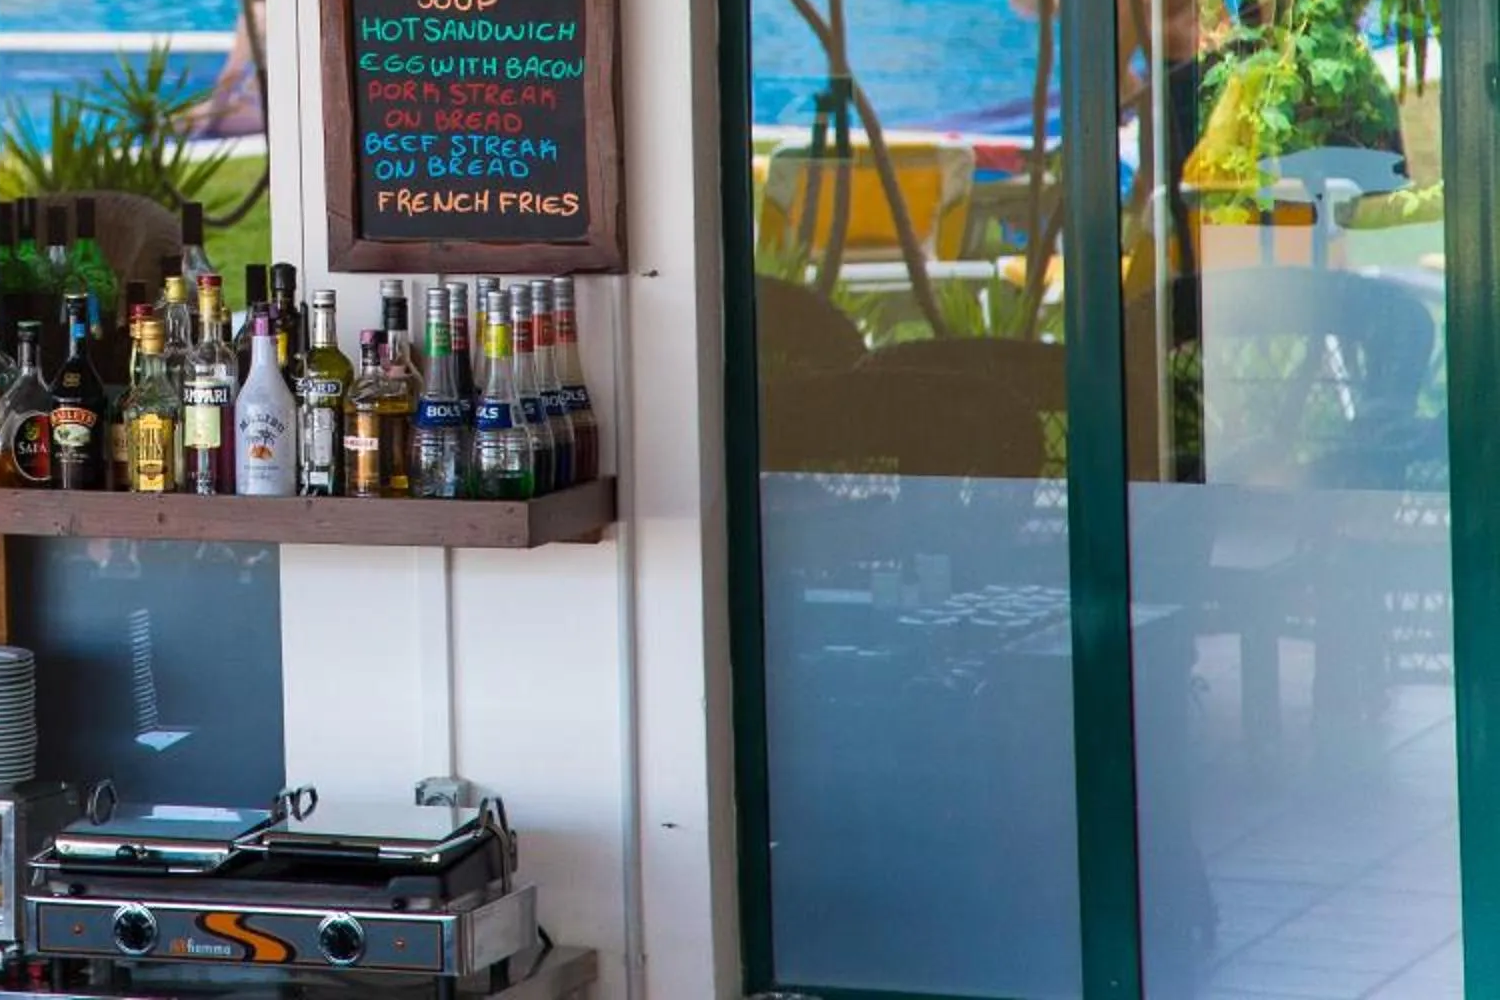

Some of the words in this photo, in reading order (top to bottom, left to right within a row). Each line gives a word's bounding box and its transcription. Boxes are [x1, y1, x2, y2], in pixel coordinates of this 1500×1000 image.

[358, 52, 425, 75] EGG
[430, 56, 498, 80] WITH
[505, 55, 585, 80] BACON
[383, 108, 422, 130] ON
[434, 110, 523, 134] BREAD
[364, 131, 438, 156] BEEF
[374, 158, 417, 181] ON
[426, 156, 530, 180] BREAD
[377, 187, 490, 217] FRENCH
[498, 191, 580, 216] FRIES
[426, 405, 461, 418] BOLS
